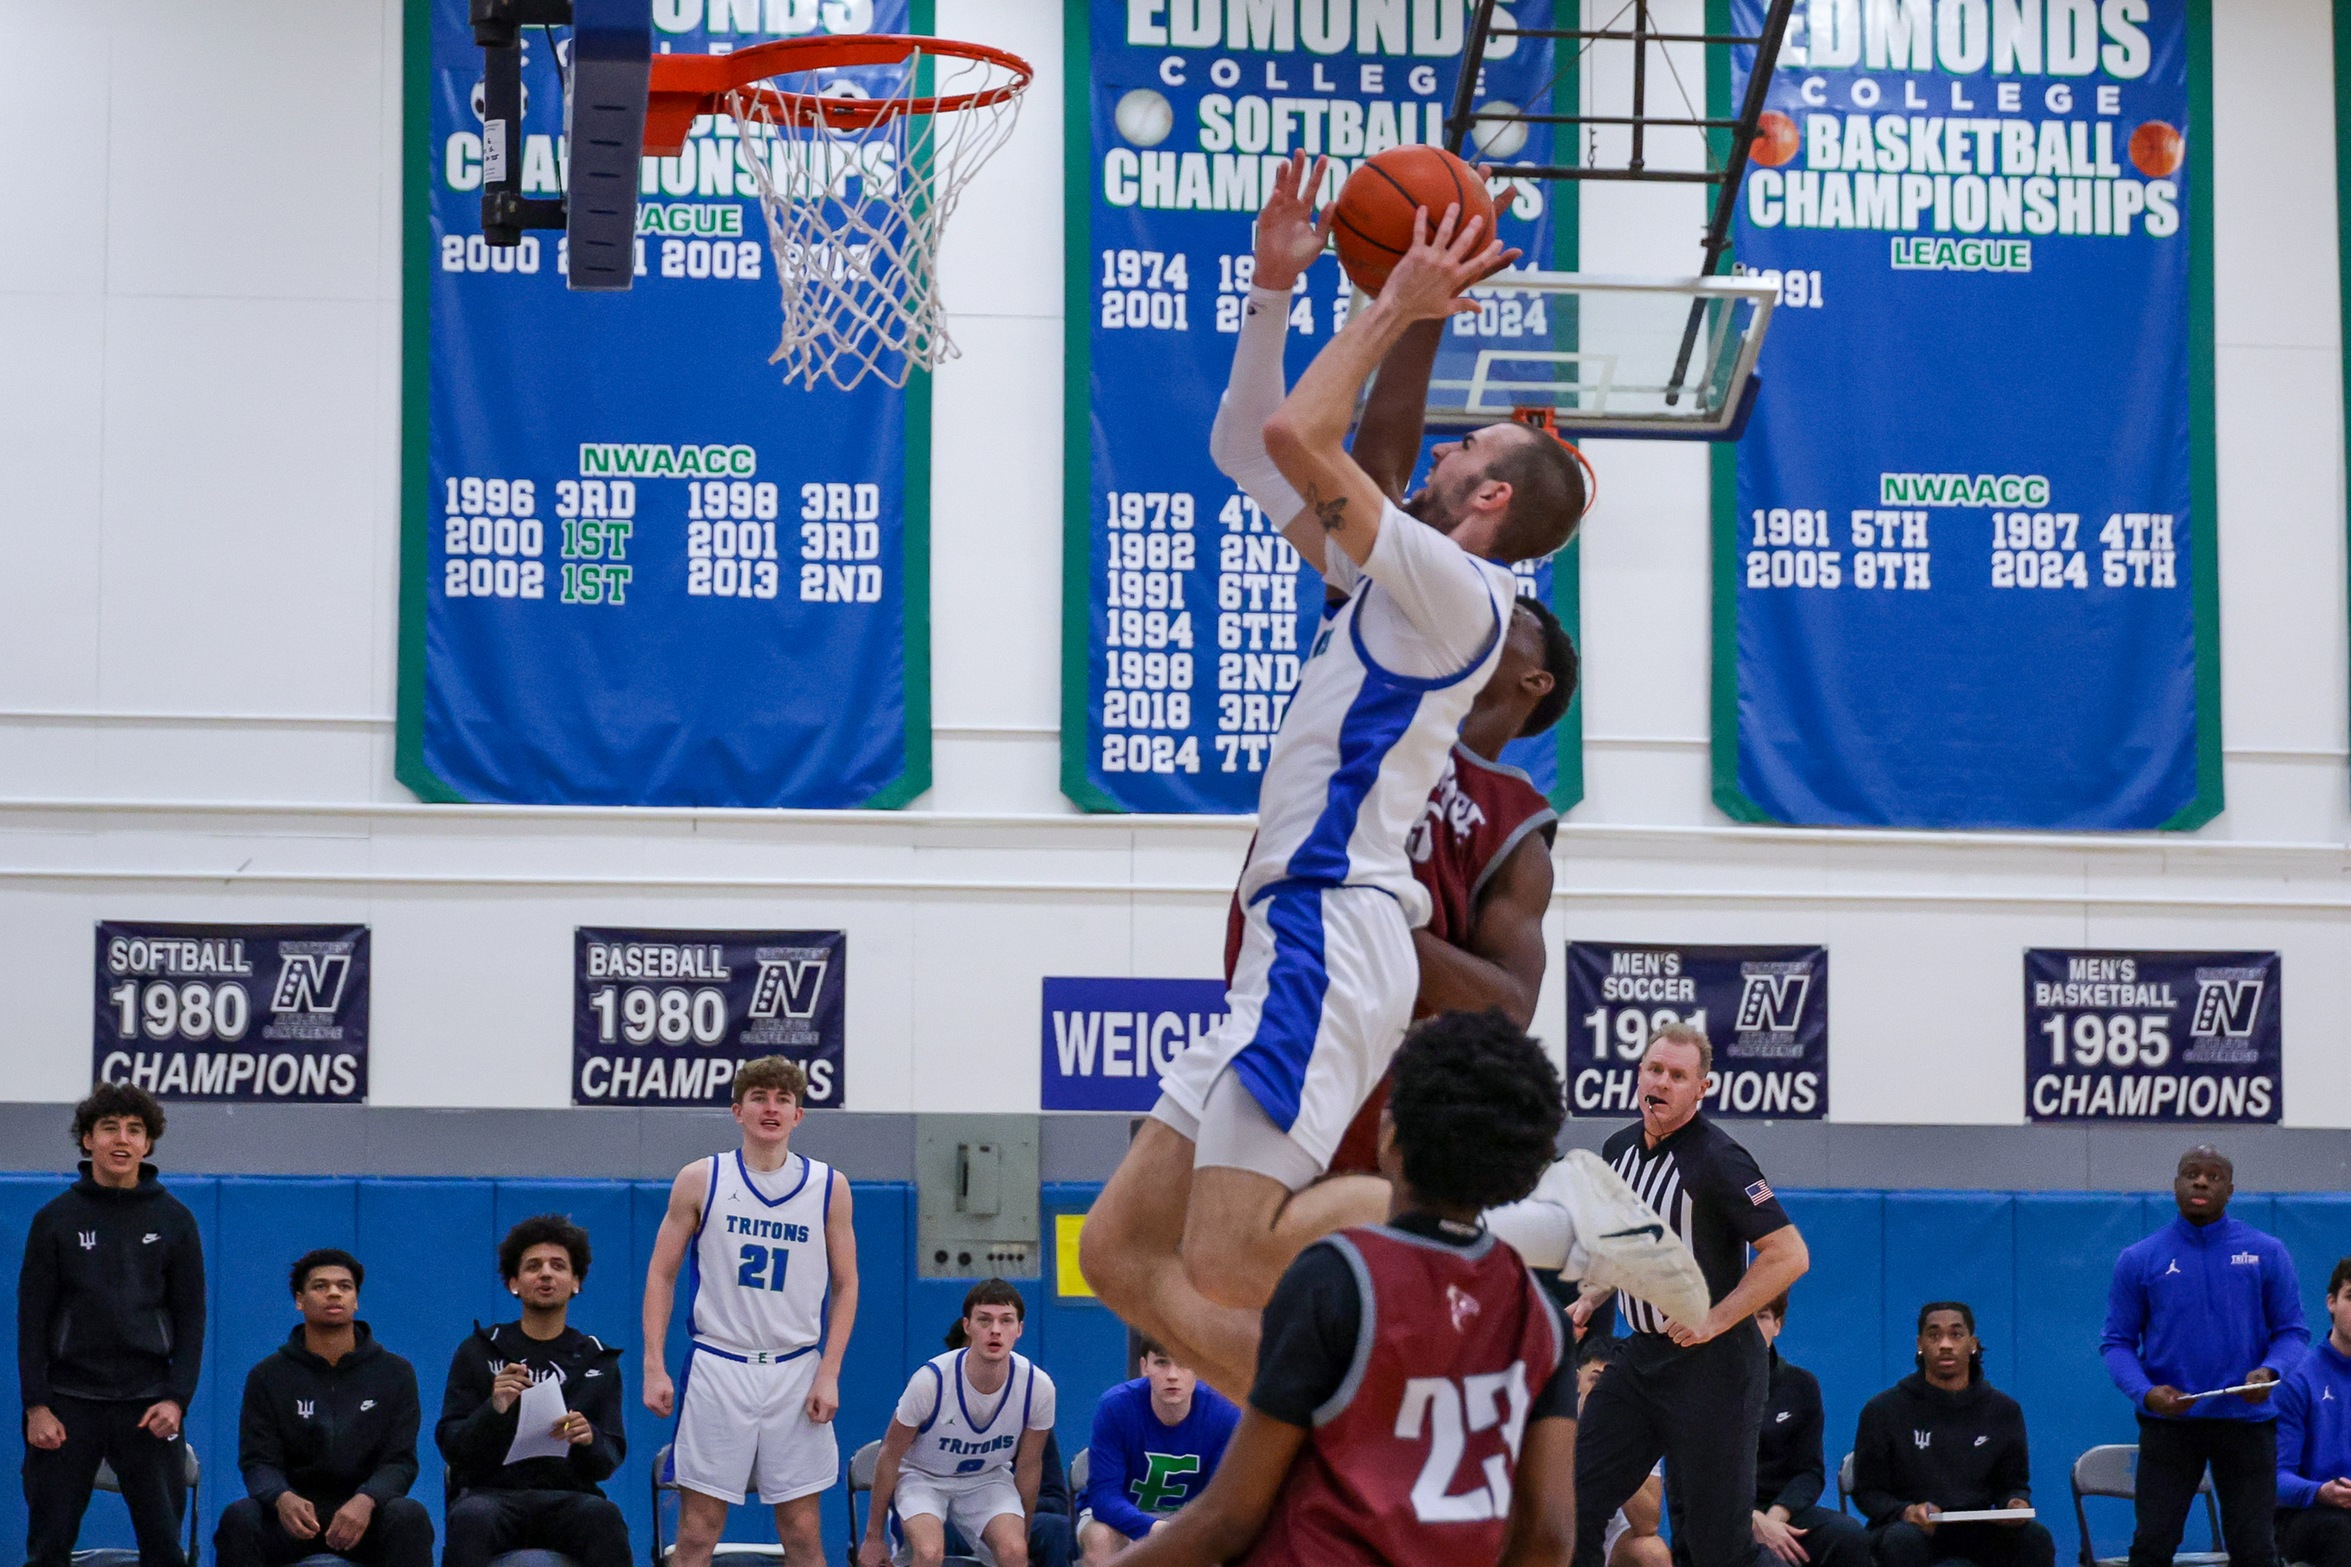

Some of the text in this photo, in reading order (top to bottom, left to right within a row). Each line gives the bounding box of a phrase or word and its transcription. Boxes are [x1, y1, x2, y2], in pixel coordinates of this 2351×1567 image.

[1801, 76, 2121, 115] COLLEGE
[1806, 114, 2121, 178] BASKETBALL
[637, 203, 743, 237] AGUE
[1748, 169, 2180, 238] CHAMPIONSHIPS
[442, 235, 539, 273] 2000
[661, 239, 761, 280] 2002
[1102, 250, 1188, 290] 1974
[1890, 236, 2033, 273] LEAGUE
[1101, 291, 1188, 330] 2001
[1453, 300, 1548, 336] 2024
[580, 443, 756, 478] NWAACC
[445, 477, 635, 518] 1996 3RD
[688, 482, 879, 520] 1998 3RD
[1880, 472, 2050, 507] NWAACC
[1107, 491, 1281, 532] 1979 4T
[1753, 509, 1928, 549] 1981 5TH
[1992, 512, 2174, 551] 1987 4TH
[445, 517, 632, 560] 2000 1ST
[688, 521, 879, 560] 2001 3RD
[1107, 532, 1300, 574] 1982 2ND
[445, 559, 632, 605] 2002 1ST
[688, 559, 882, 602] 2013 2ND
[1747, 551, 1930, 590] 2005 8TH
[1991, 550, 2176, 588] 2024 5TH
[1107, 569, 1297, 612] 1991 6TH
[1106, 609, 1193, 650] 1994
[1218, 613, 1297, 651] 6TH
[1106, 650, 1300, 692] 1998 2ND
[1103, 690, 1190, 730] 2018
[1102, 734, 1277, 774] 2024 7T
[109, 938, 251, 974] SOFTBALL
[588, 943, 731, 980] BASEBALL
[1611, 952, 1681, 976] MEN'S
[2069, 957, 2137, 983] MEN'S
[1603, 977, 1696, 1001] SOCCER
[2035, 983, 2178, 1008] BASKETBALL
[111, 981, 249, 1039] 1980
[591, 987, 727, 1045] 1980
[2042, 1013, 2171, 1067] 1985
[101, 1051, 358, 1095] CHAMPIONS
[2033, 1073, 2273, 1118] CHAMPIONS
[726, 1214, 810, 1243] TRITONS
[738, 1243, 790, 1292] 21
[939, 1435, 1015, 1455] TRITONS
